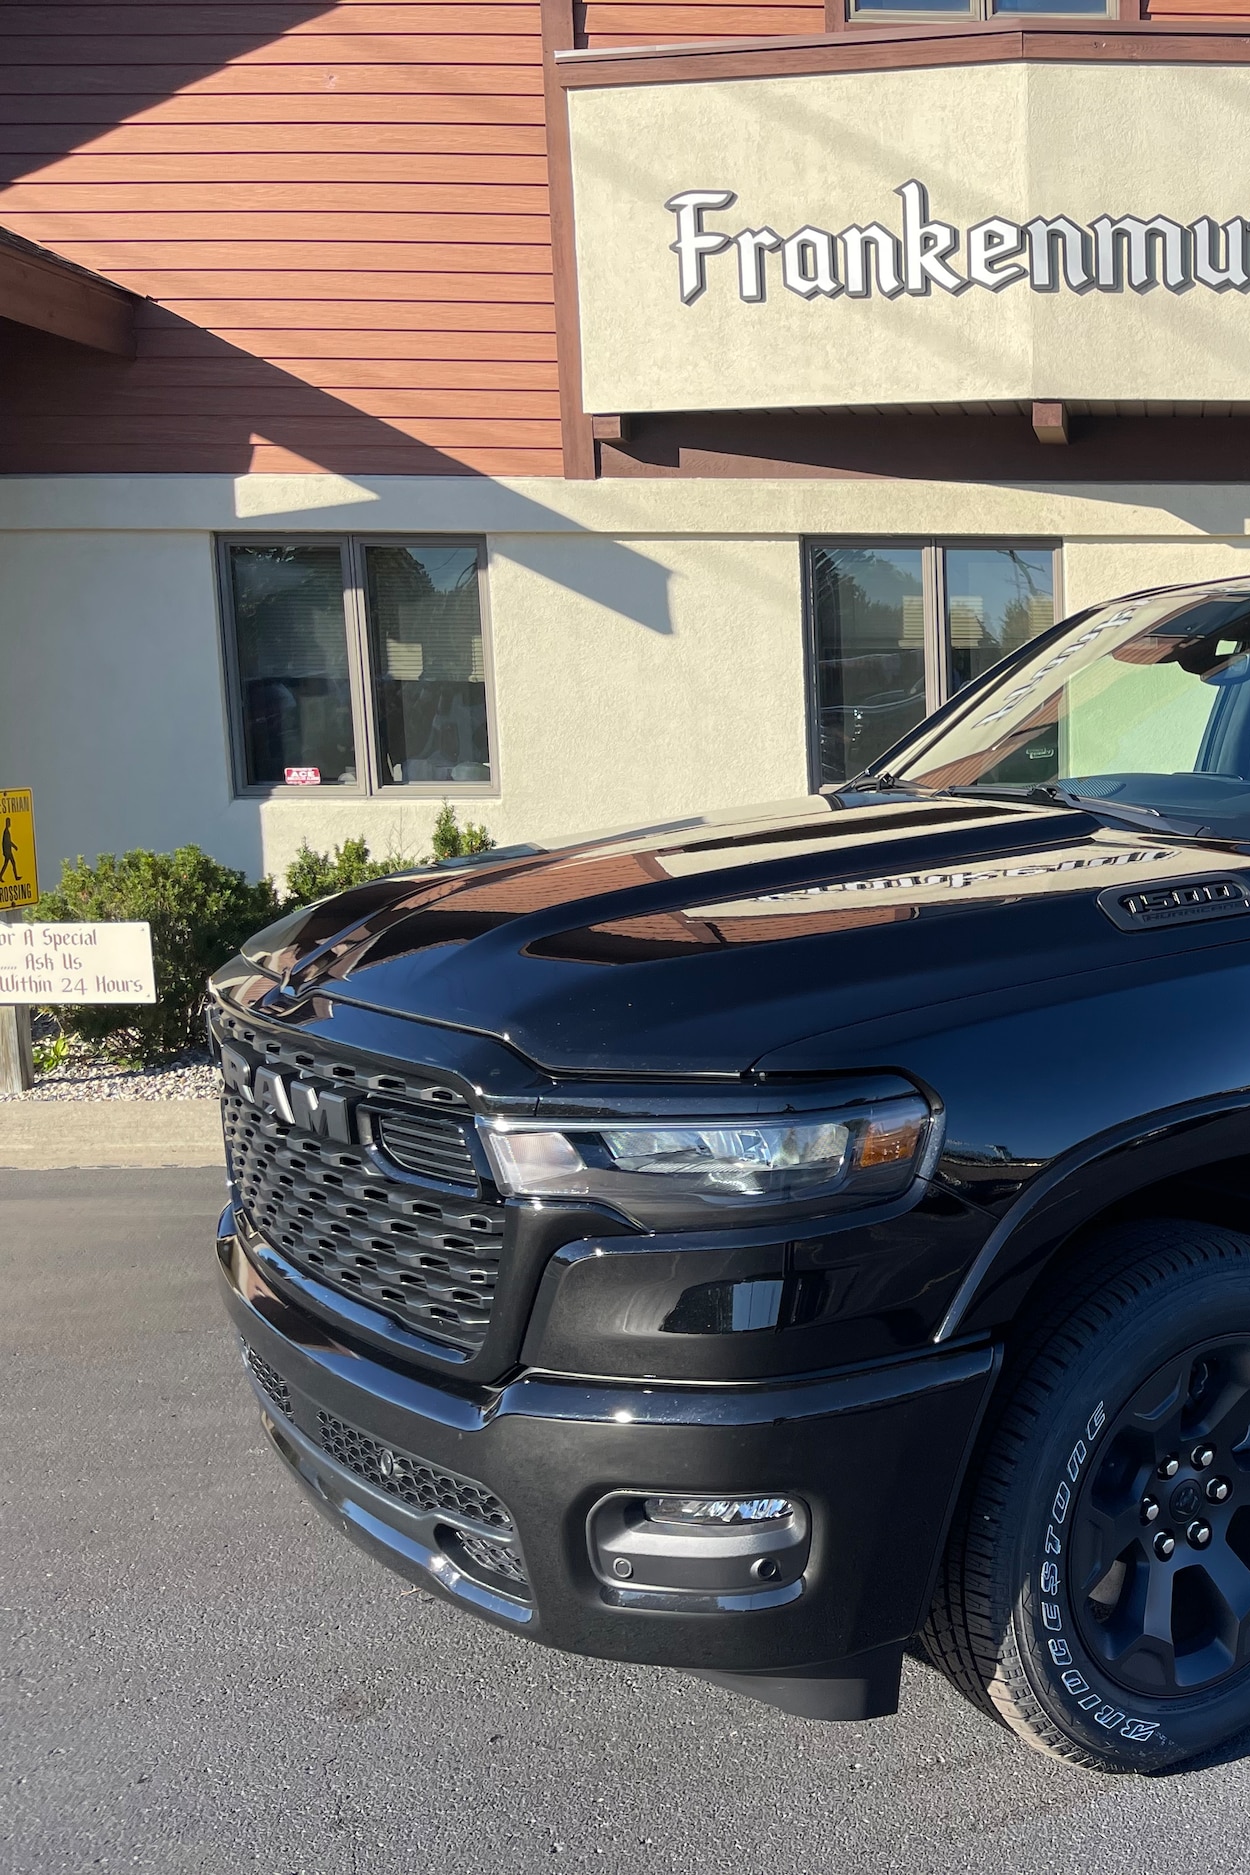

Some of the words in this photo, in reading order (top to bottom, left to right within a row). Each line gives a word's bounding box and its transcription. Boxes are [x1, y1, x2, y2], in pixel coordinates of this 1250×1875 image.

[0, 796, 29, 813] STRIAN
[1124, 882, 1237, 914] 1500
[24, 928, 34, 947] A
[42, 928, 97, 951] Special
[25, 952, 54, 971] Ask
[62, 953, 83, 970] Us
[0, 974, 52, 994] Within
[61, 977, 88, 996] 24
[96, 975, 143, 994] Hours
[221, 1039, 352, 1145] RAM
[1041, 1401, 1160, 1742] BRIDGESTONE
